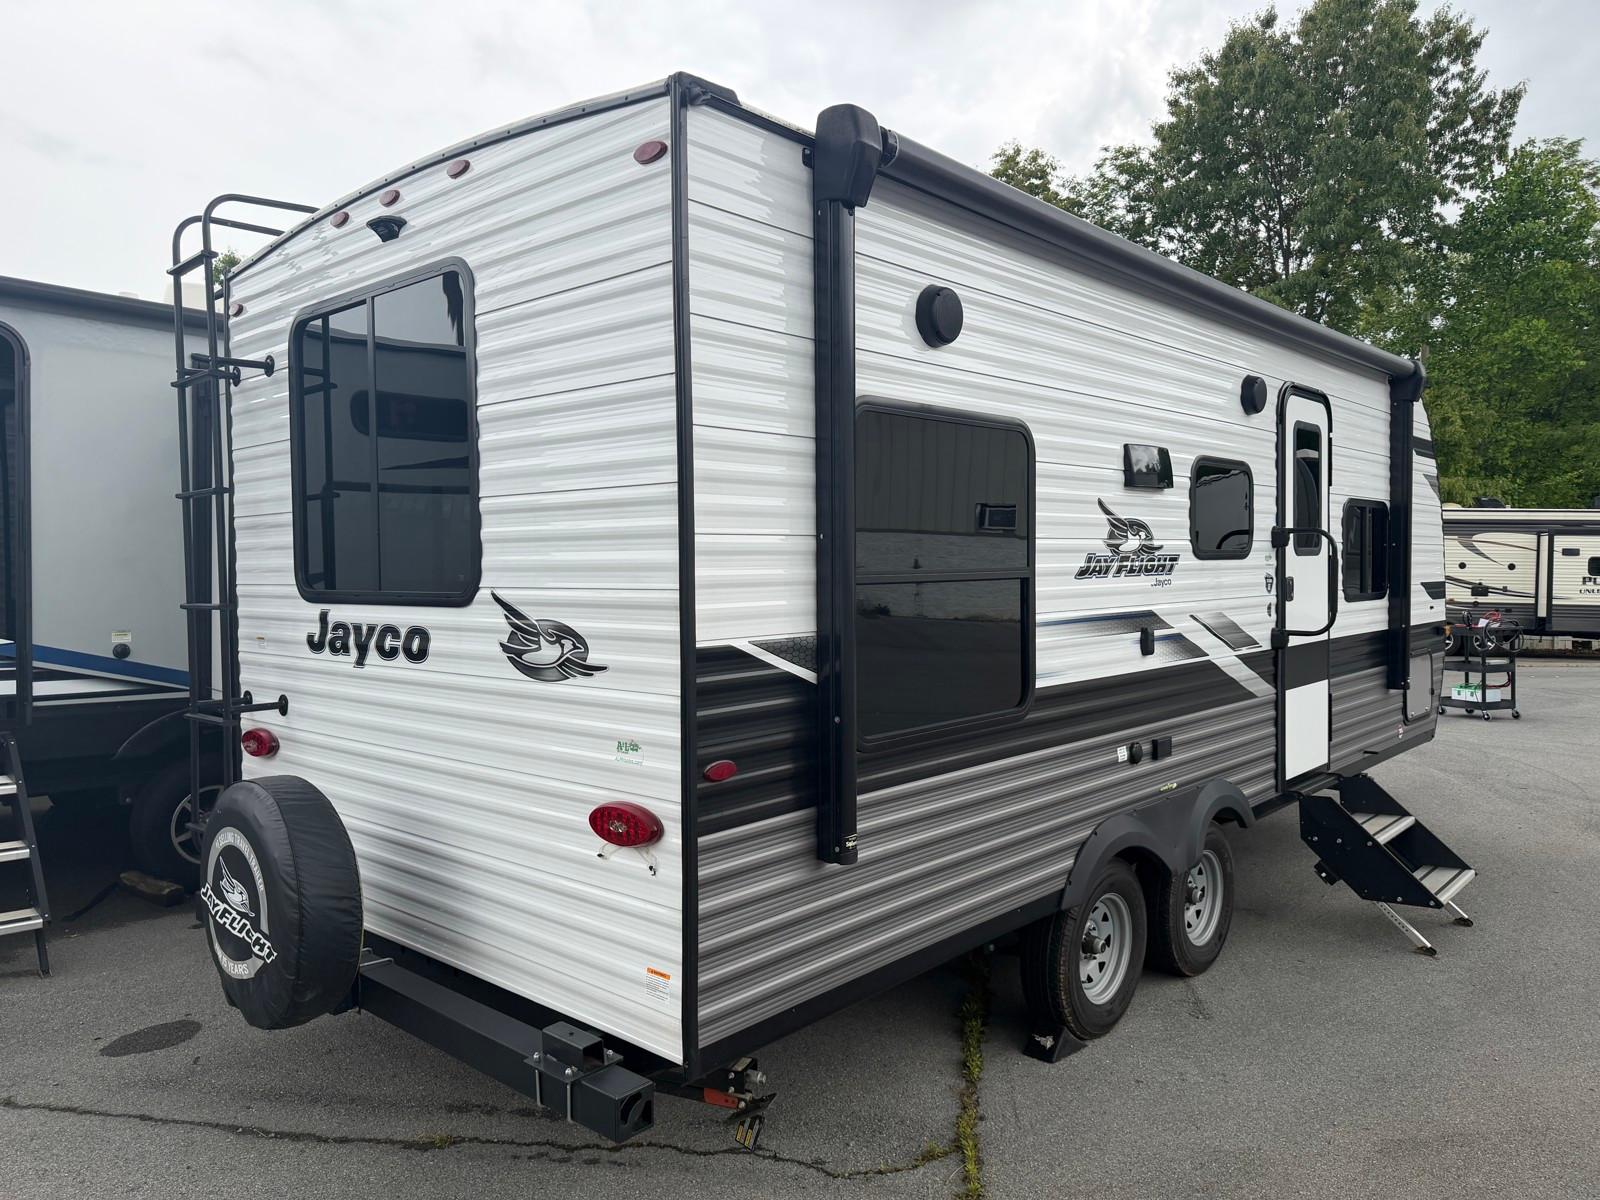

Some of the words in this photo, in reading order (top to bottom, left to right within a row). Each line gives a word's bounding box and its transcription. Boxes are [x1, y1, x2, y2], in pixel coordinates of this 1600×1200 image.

[1153, 577, 1172, 588] Jayco
[306, 608, 431, 668] Jayco
[219, 831, 234, 846] SELLING
[234, 833, 250, 857] TRAVEL
[249, 853, 264, 891] TRAILER
[228, 960, 249, 975] YEARS
